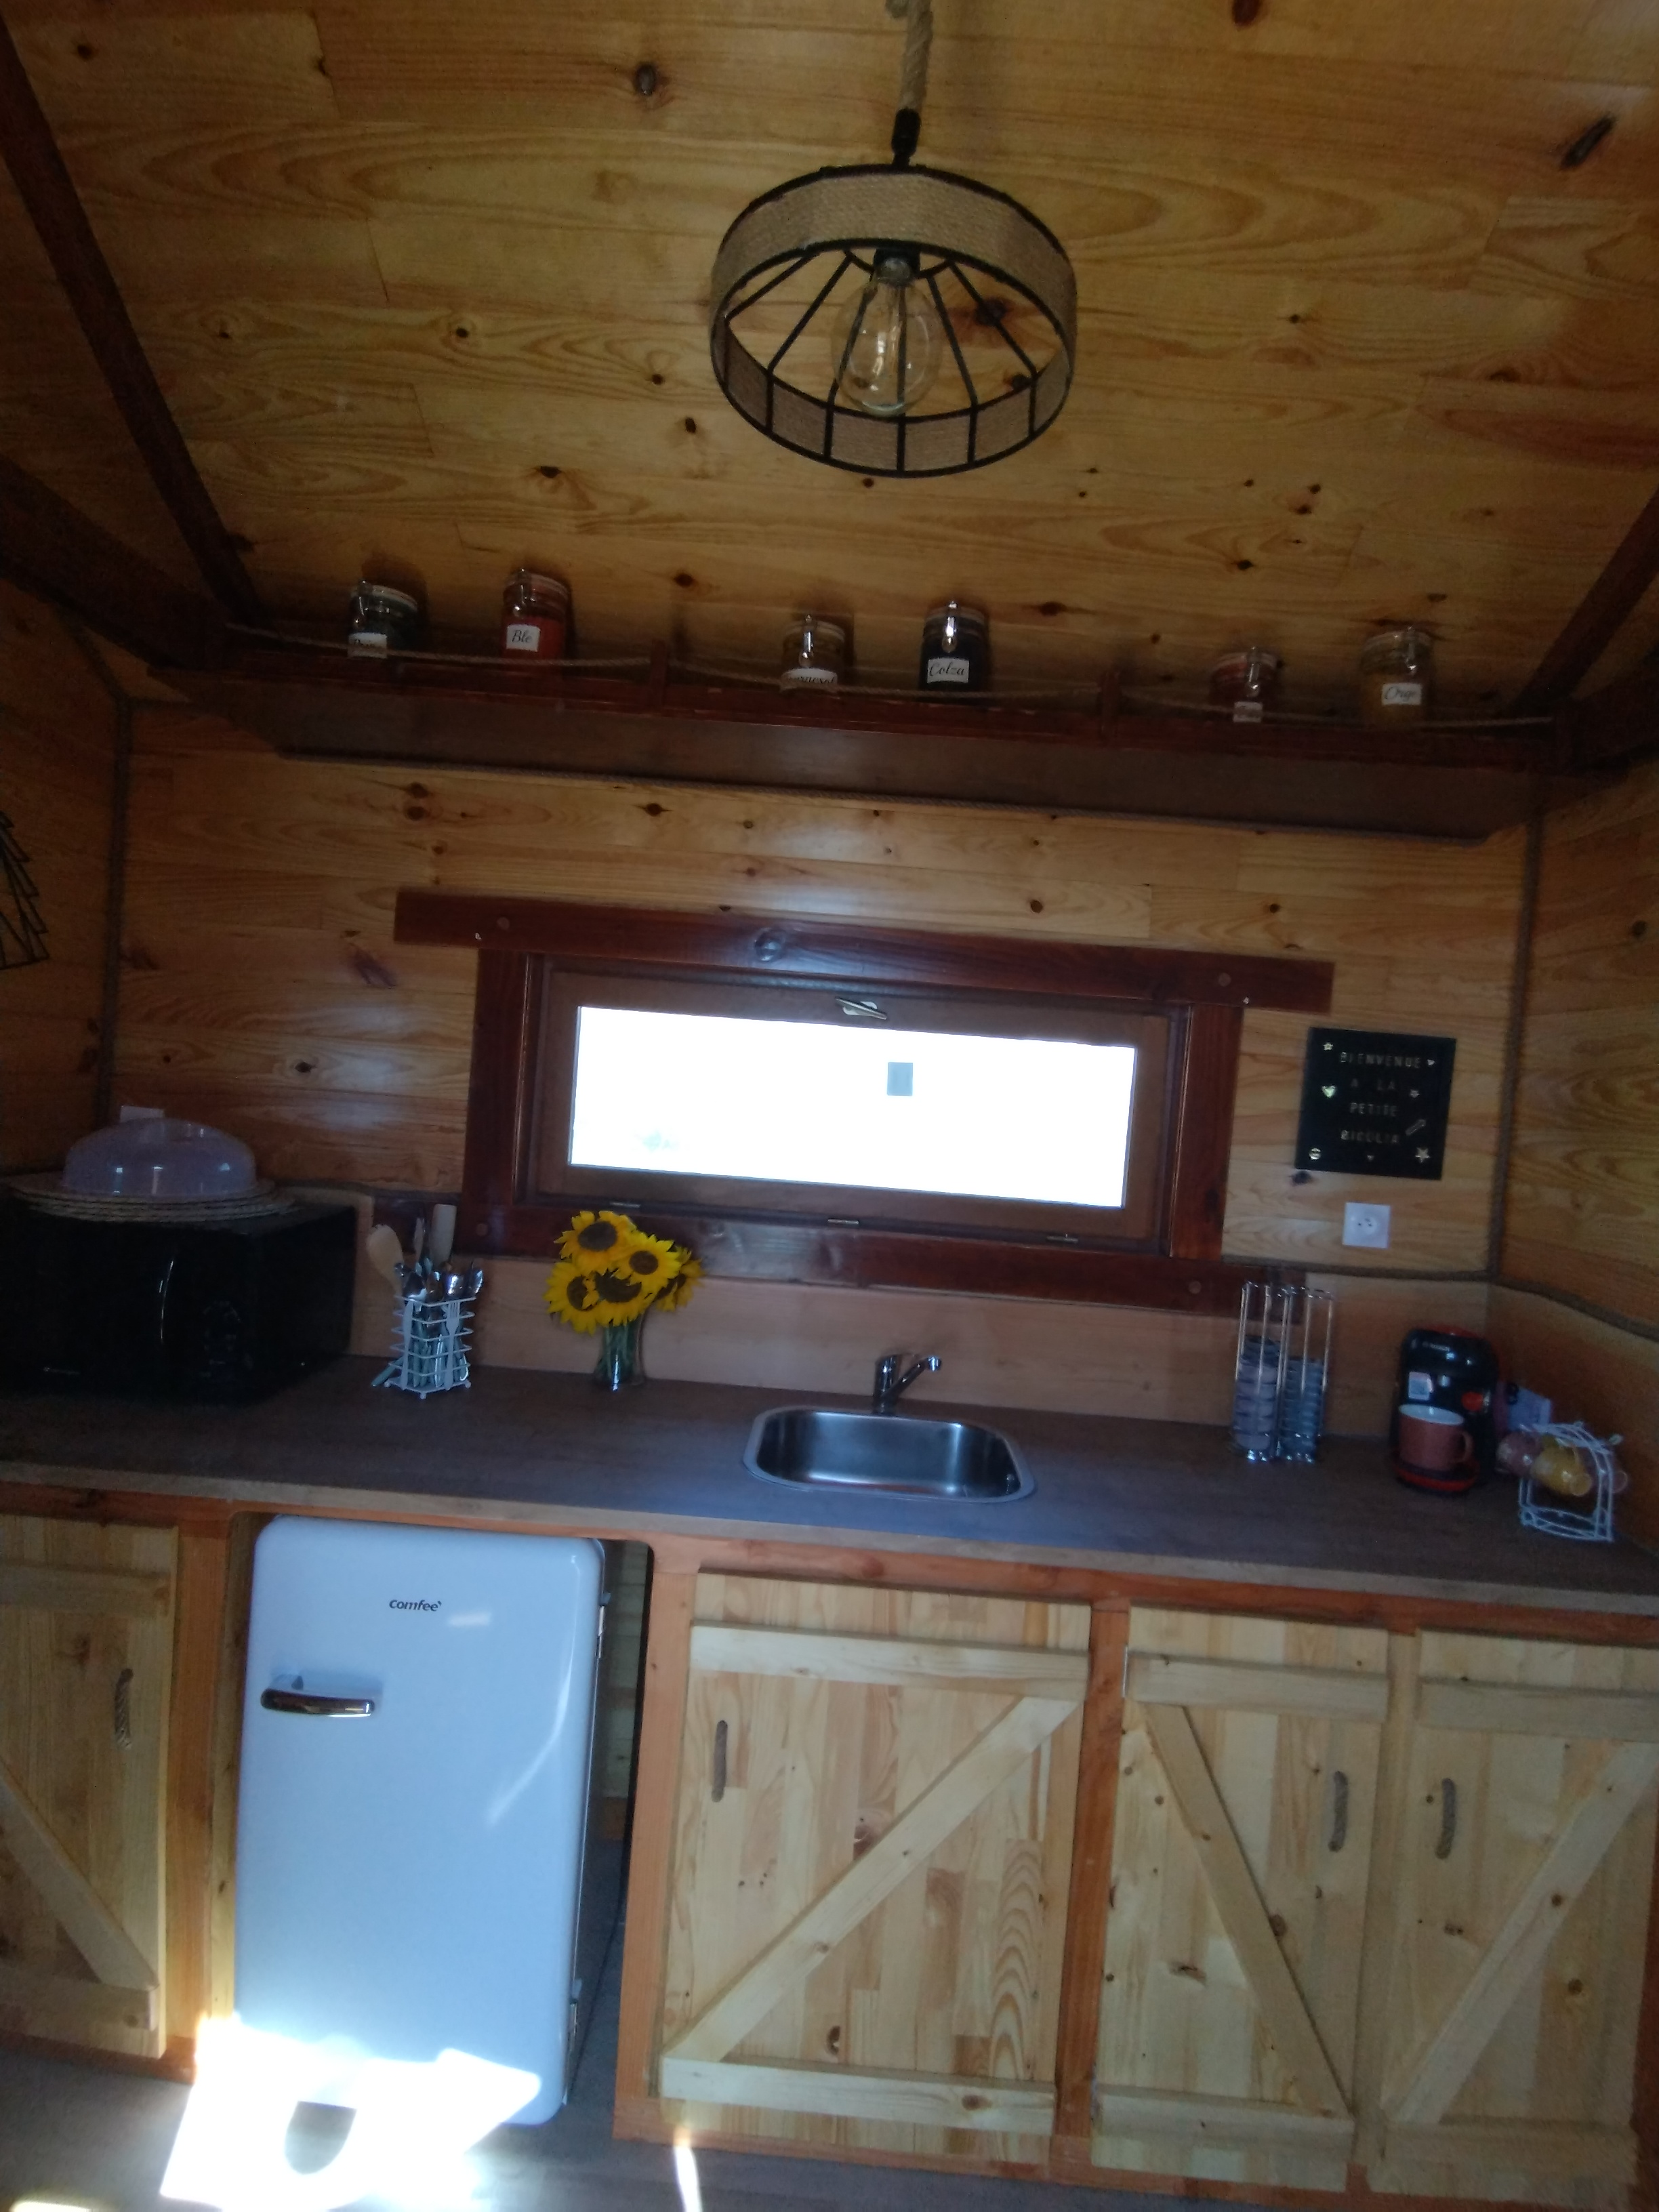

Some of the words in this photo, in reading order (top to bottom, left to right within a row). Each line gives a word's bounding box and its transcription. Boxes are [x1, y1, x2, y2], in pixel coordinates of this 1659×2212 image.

[928, 661, 965, 676] Colza
[1339, 1051, 1421, 1069] BIENVENUE
[1349, 1102, 1398, 1118] PETITE
